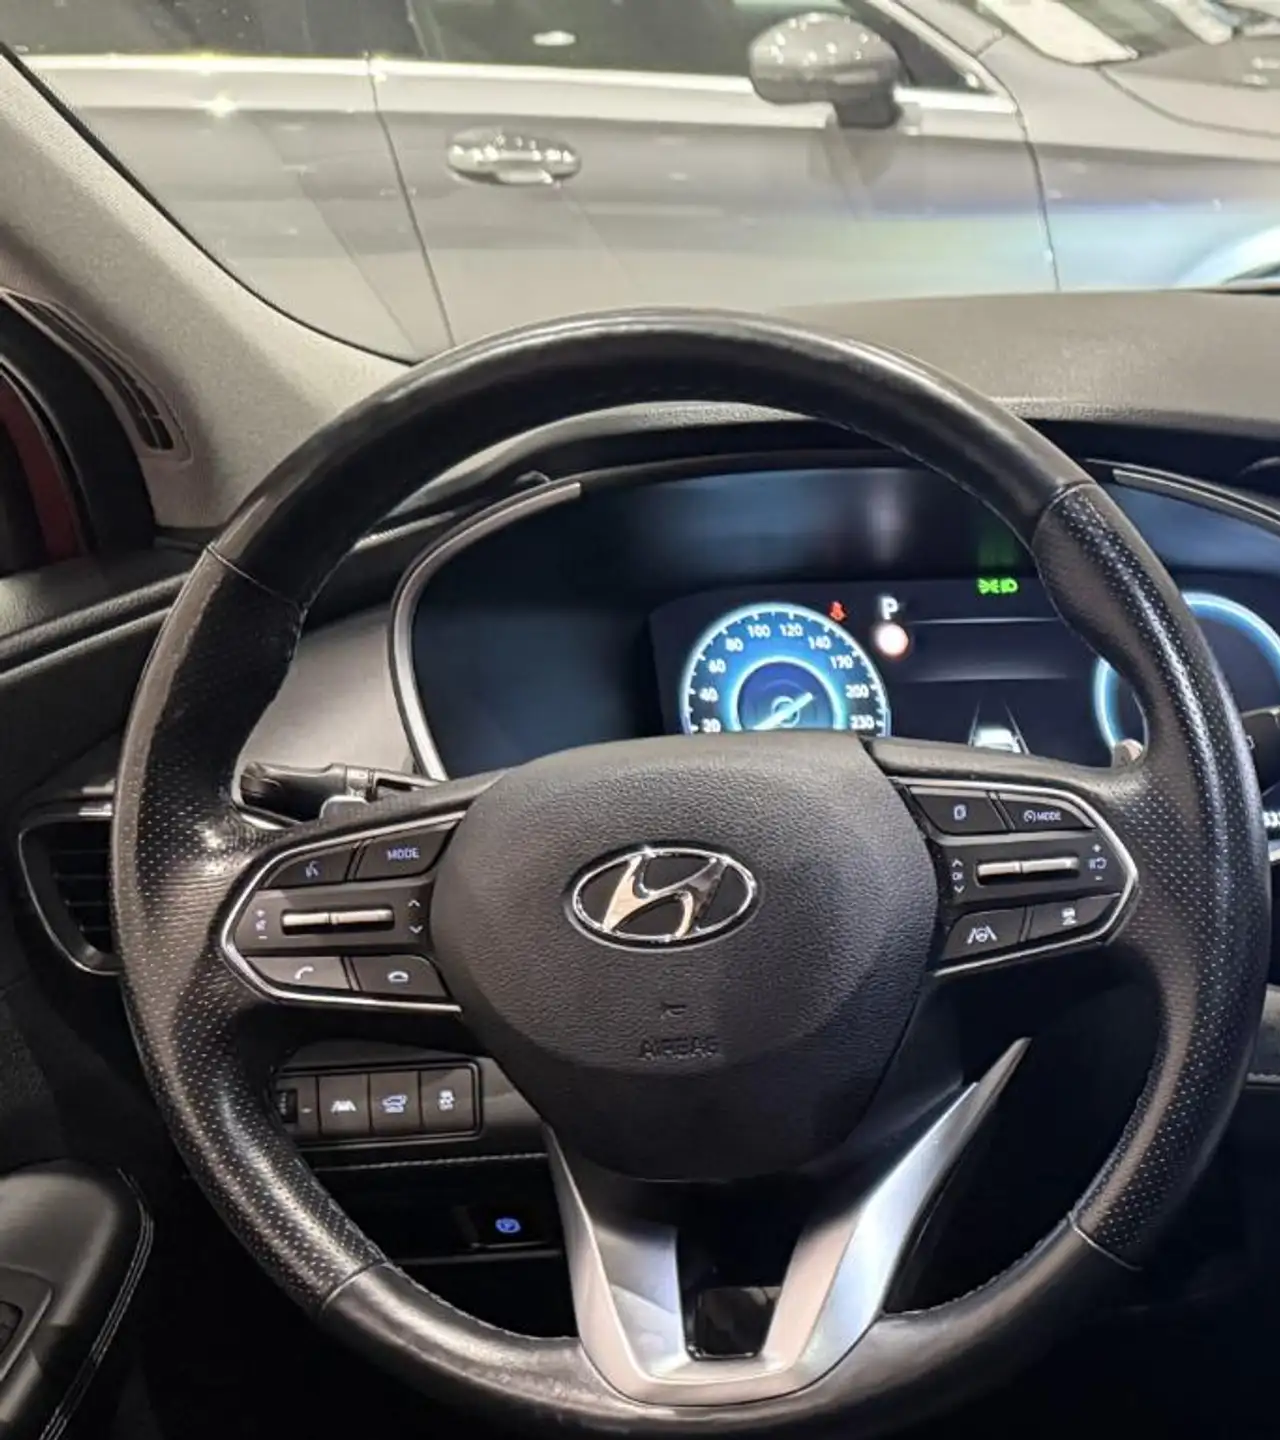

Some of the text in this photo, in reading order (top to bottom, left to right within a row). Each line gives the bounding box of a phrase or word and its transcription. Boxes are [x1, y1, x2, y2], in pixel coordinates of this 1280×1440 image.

[747, 624, 771, 638] 100
[779, 623, 804, 637] 120
[725, 637, 744, 652] 80
[808, 635, 832, 650] 140
[708, 658, 726, 674] 60
[1036, 810, 1062, 822] MODE
[387, 847, 420, 861] MODE
